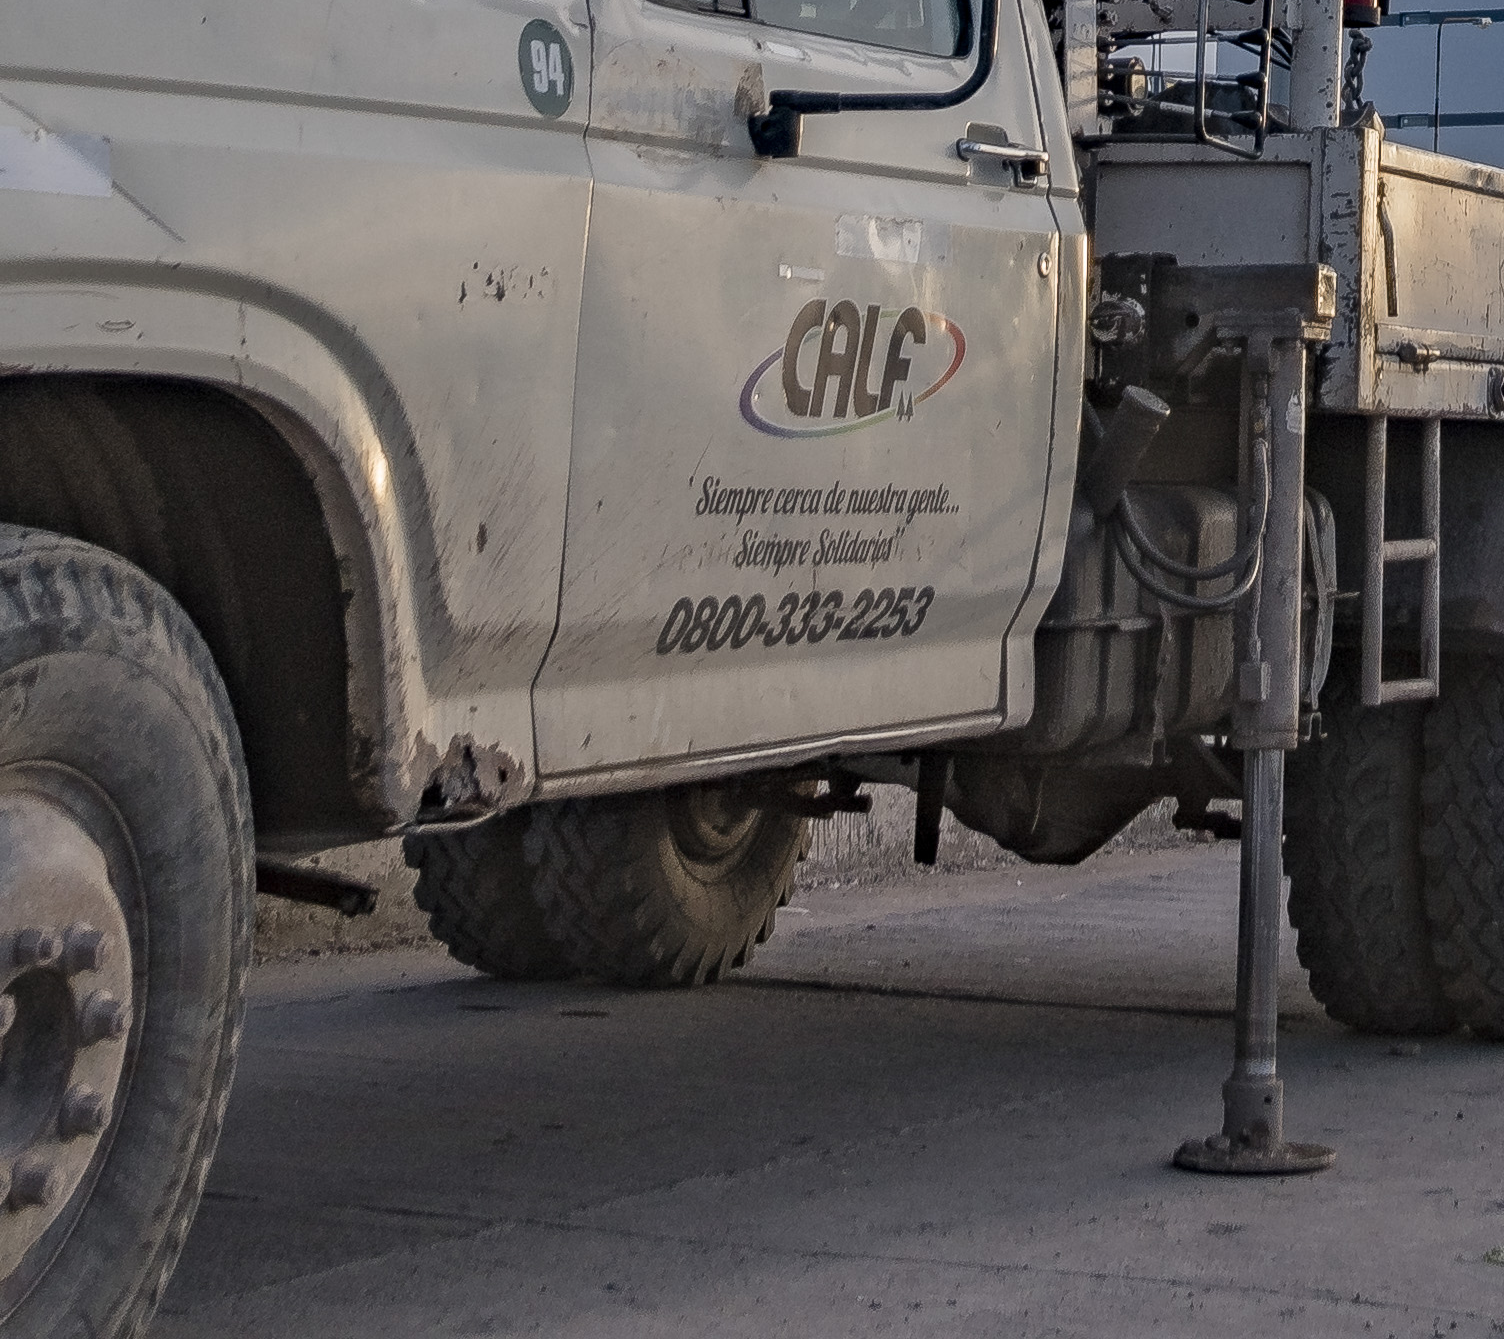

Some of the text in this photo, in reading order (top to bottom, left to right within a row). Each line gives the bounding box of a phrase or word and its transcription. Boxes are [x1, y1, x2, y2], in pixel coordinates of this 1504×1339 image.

[530, 39, 565, 95] 94
[782, 298, 927, 419] CALF
[774, 487, 823, 515] cerca
[824, 480, 847, 515] de
[846, 482, 908, 515] nuestra
[905, 482, 960, 524] gente...
[735, 528, 811, 577] Siempre
[656, 585, 935, 655] 0800-333-2253
